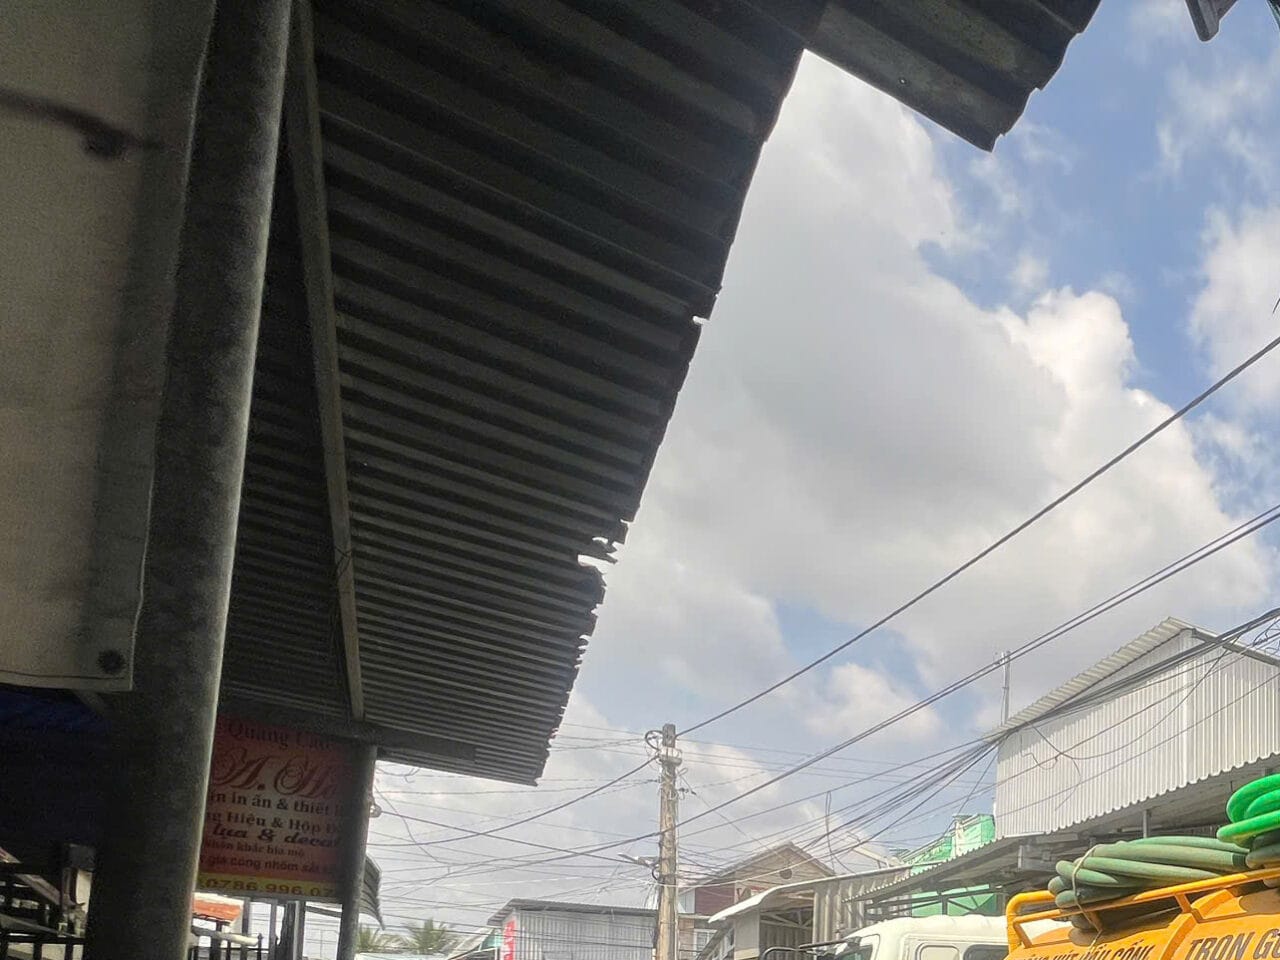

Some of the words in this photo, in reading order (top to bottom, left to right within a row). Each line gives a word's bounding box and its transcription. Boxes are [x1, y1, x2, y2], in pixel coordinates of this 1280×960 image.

[276, 798, 289, 810] &
[271, 817, 283, 829] &
[257, 828, 276, 842] &
